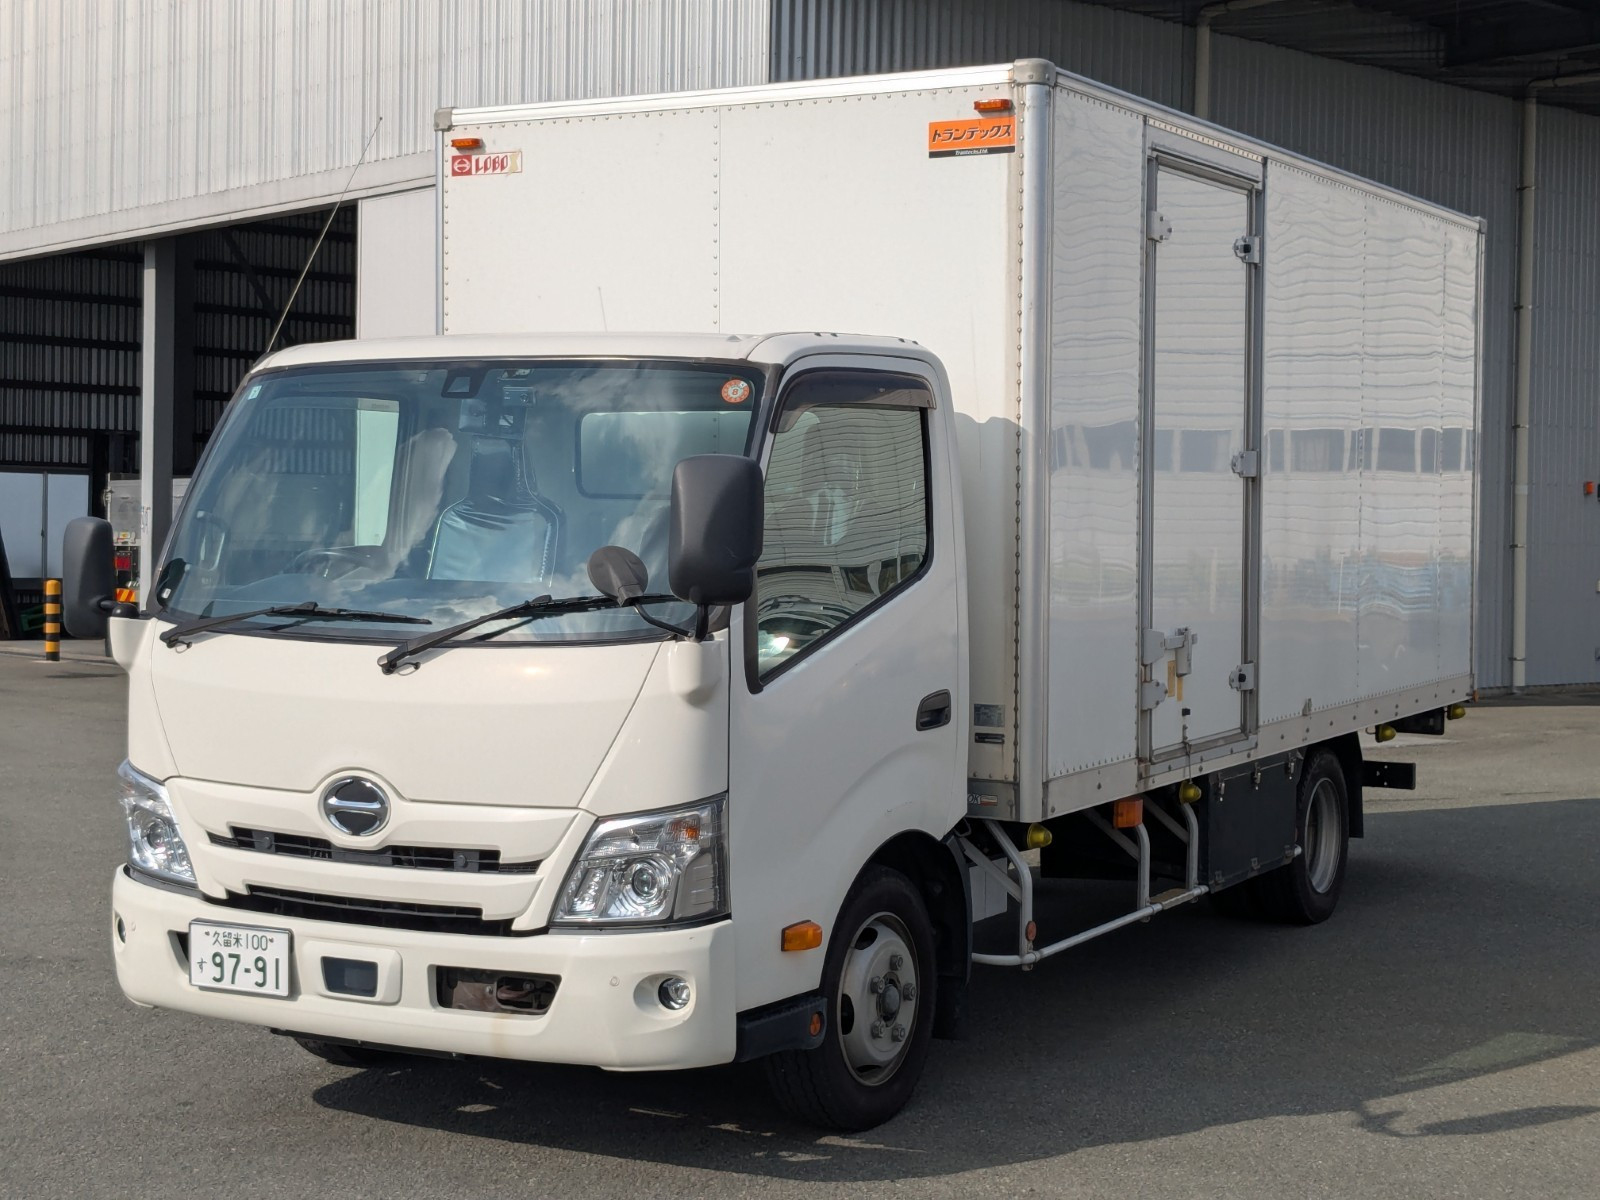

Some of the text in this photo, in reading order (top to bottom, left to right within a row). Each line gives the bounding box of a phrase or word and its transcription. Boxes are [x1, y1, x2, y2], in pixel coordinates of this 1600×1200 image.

[932, 124, 1011, 143] トランテックス
[475, 154, 518, 174] LOBO
[212, 951, 280, 990] 97-91
